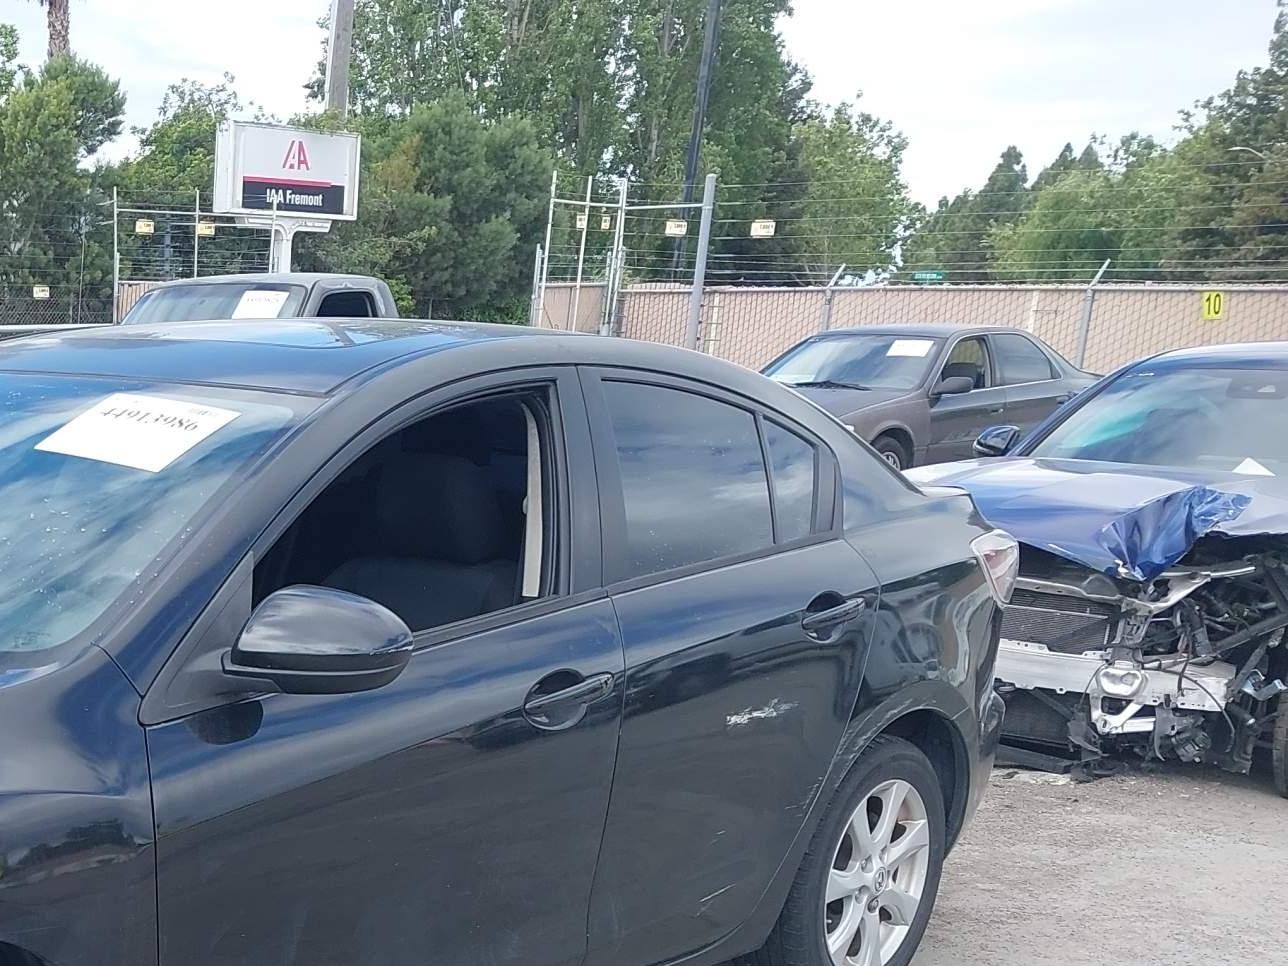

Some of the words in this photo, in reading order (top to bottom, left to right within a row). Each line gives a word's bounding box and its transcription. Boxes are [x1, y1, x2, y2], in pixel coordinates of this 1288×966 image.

[266, 188, 285, 203] IAA
[286, 189, 323, 207] Fremont
[1205, 293, 1222, 315] 10
